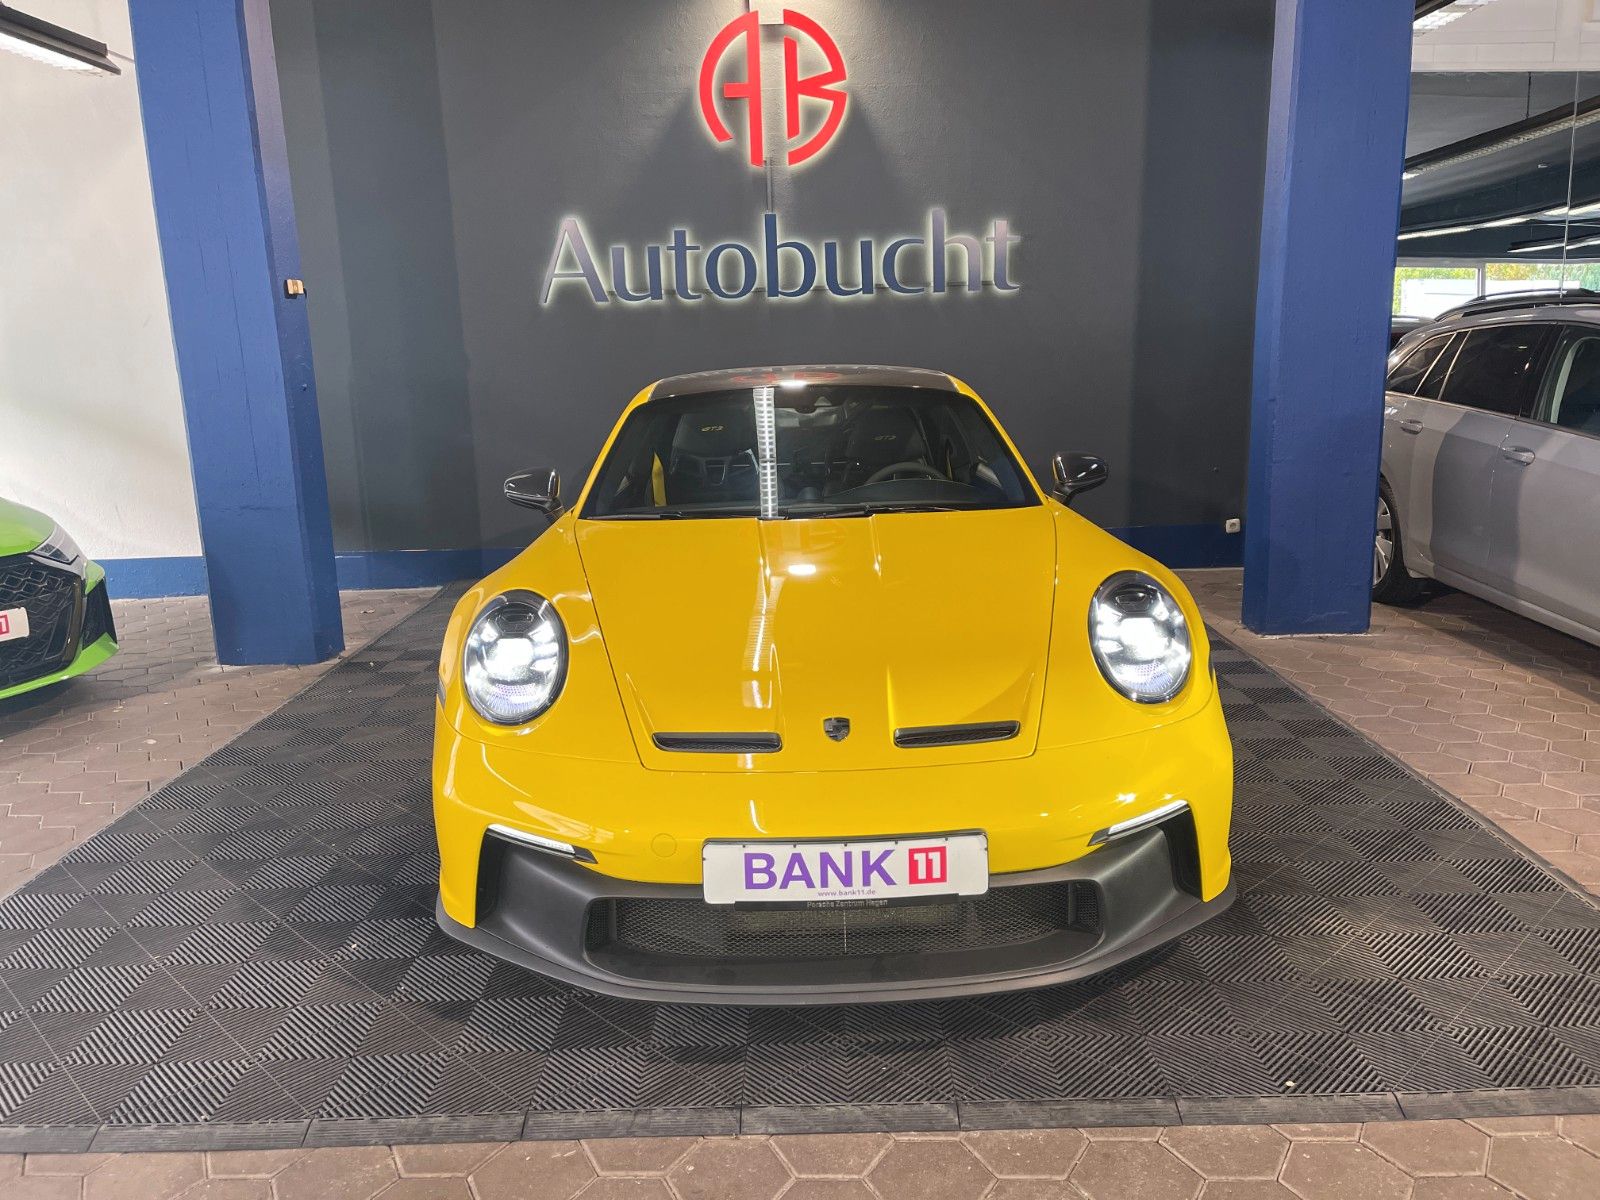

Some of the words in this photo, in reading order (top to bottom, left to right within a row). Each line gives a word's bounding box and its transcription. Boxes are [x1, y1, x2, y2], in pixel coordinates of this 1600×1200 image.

[540, 210, 1020, 304] Autobucht
[744, 850, 897, 889] BANK
[914, 851, 941, 879] 11
[817, 889, 876, 897] www.bank11.de
